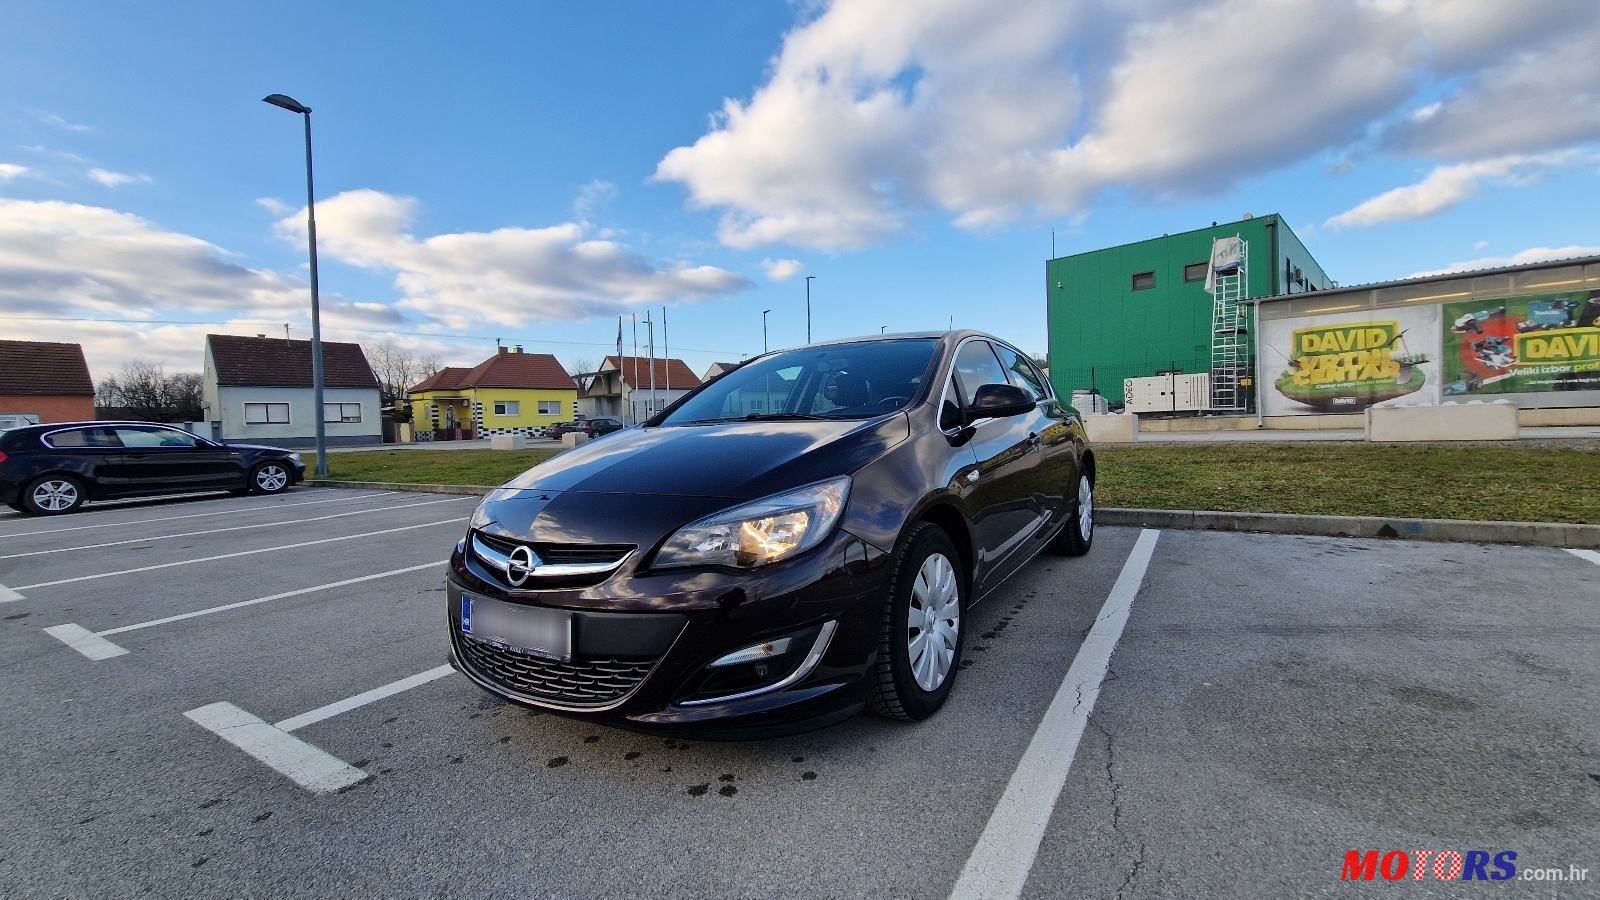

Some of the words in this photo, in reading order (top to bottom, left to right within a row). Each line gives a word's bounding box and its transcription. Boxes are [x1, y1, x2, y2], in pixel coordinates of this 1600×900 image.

[1302, 328, 1388, 352] DAVID
[1526, 334, 1600, 358] DAVI
[1508, 366, 1540, 377] Veliki
[1541, 364, 1572, 374] izbor
